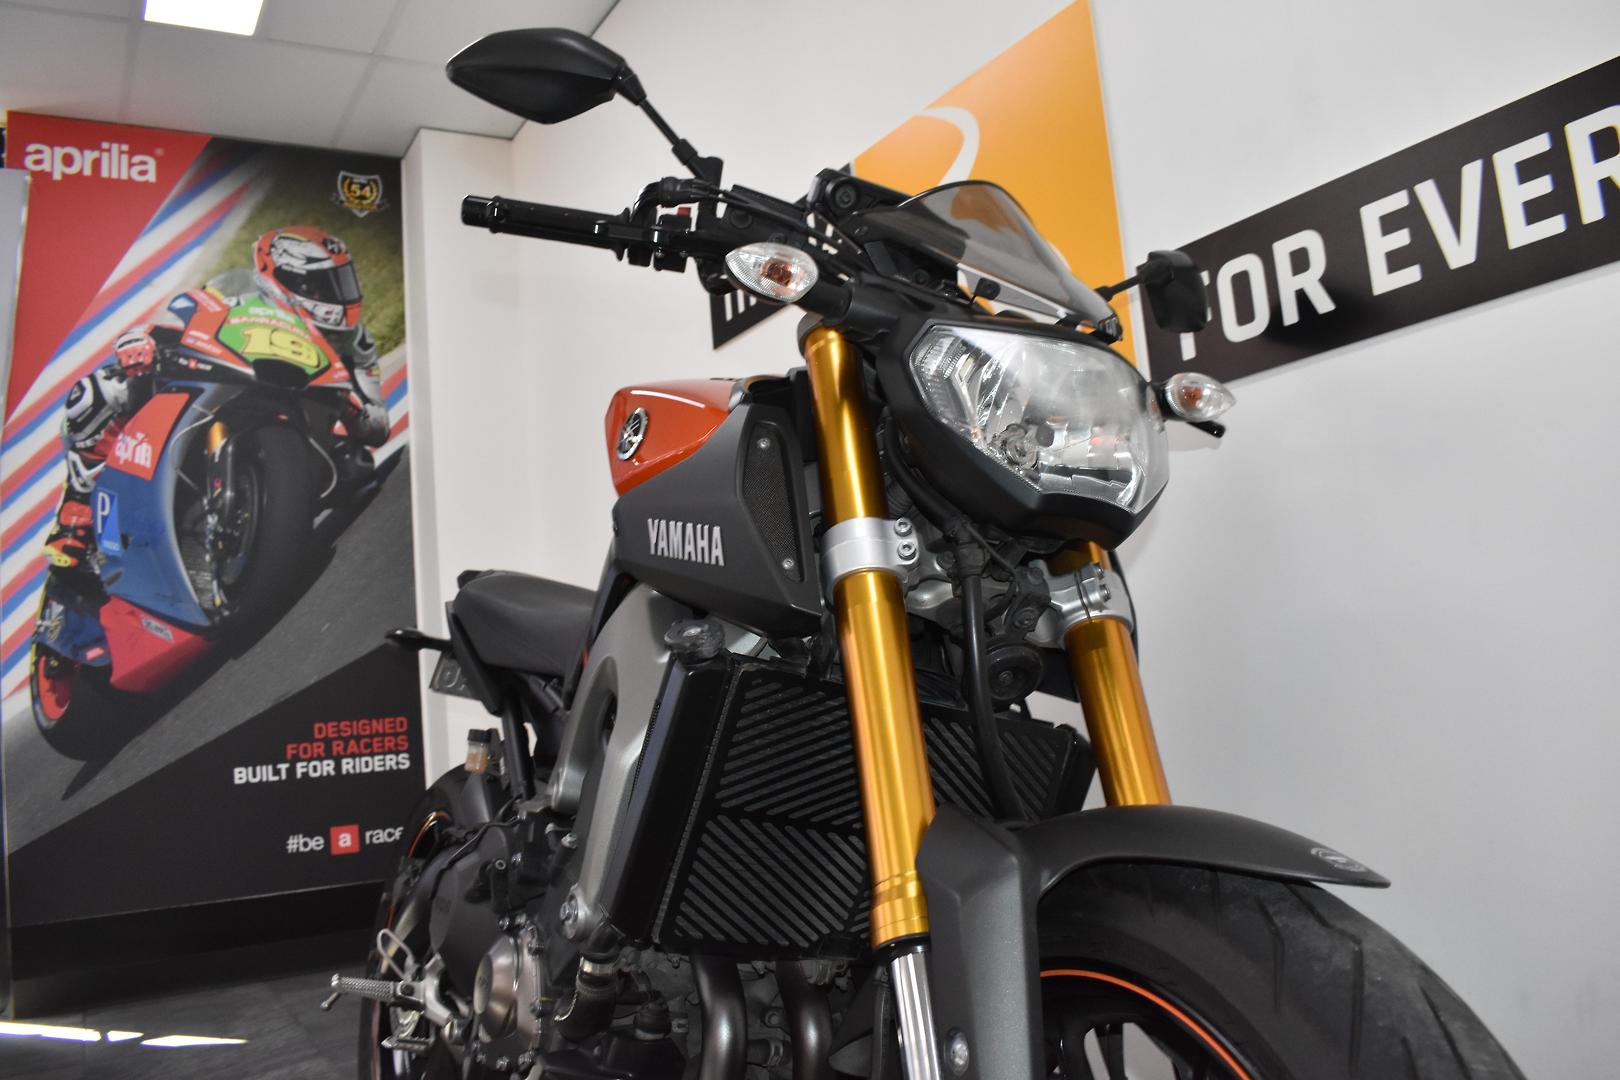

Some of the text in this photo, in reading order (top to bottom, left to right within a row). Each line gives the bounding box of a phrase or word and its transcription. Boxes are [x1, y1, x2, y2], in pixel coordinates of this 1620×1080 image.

[24, 142, 157, 183] aprilia
[241, 326, 321, 369] 19
[647, 518, 724, 566] YAMAHA
[314, 716, 408, 739] DESIGNED
[286, 736, 409, 760] FOR RACERS
[233, 753, 411, 784] BUILT FOR RIDERS
[286, 833, 325, 853] #be
[338, 832, 352, 847] a
